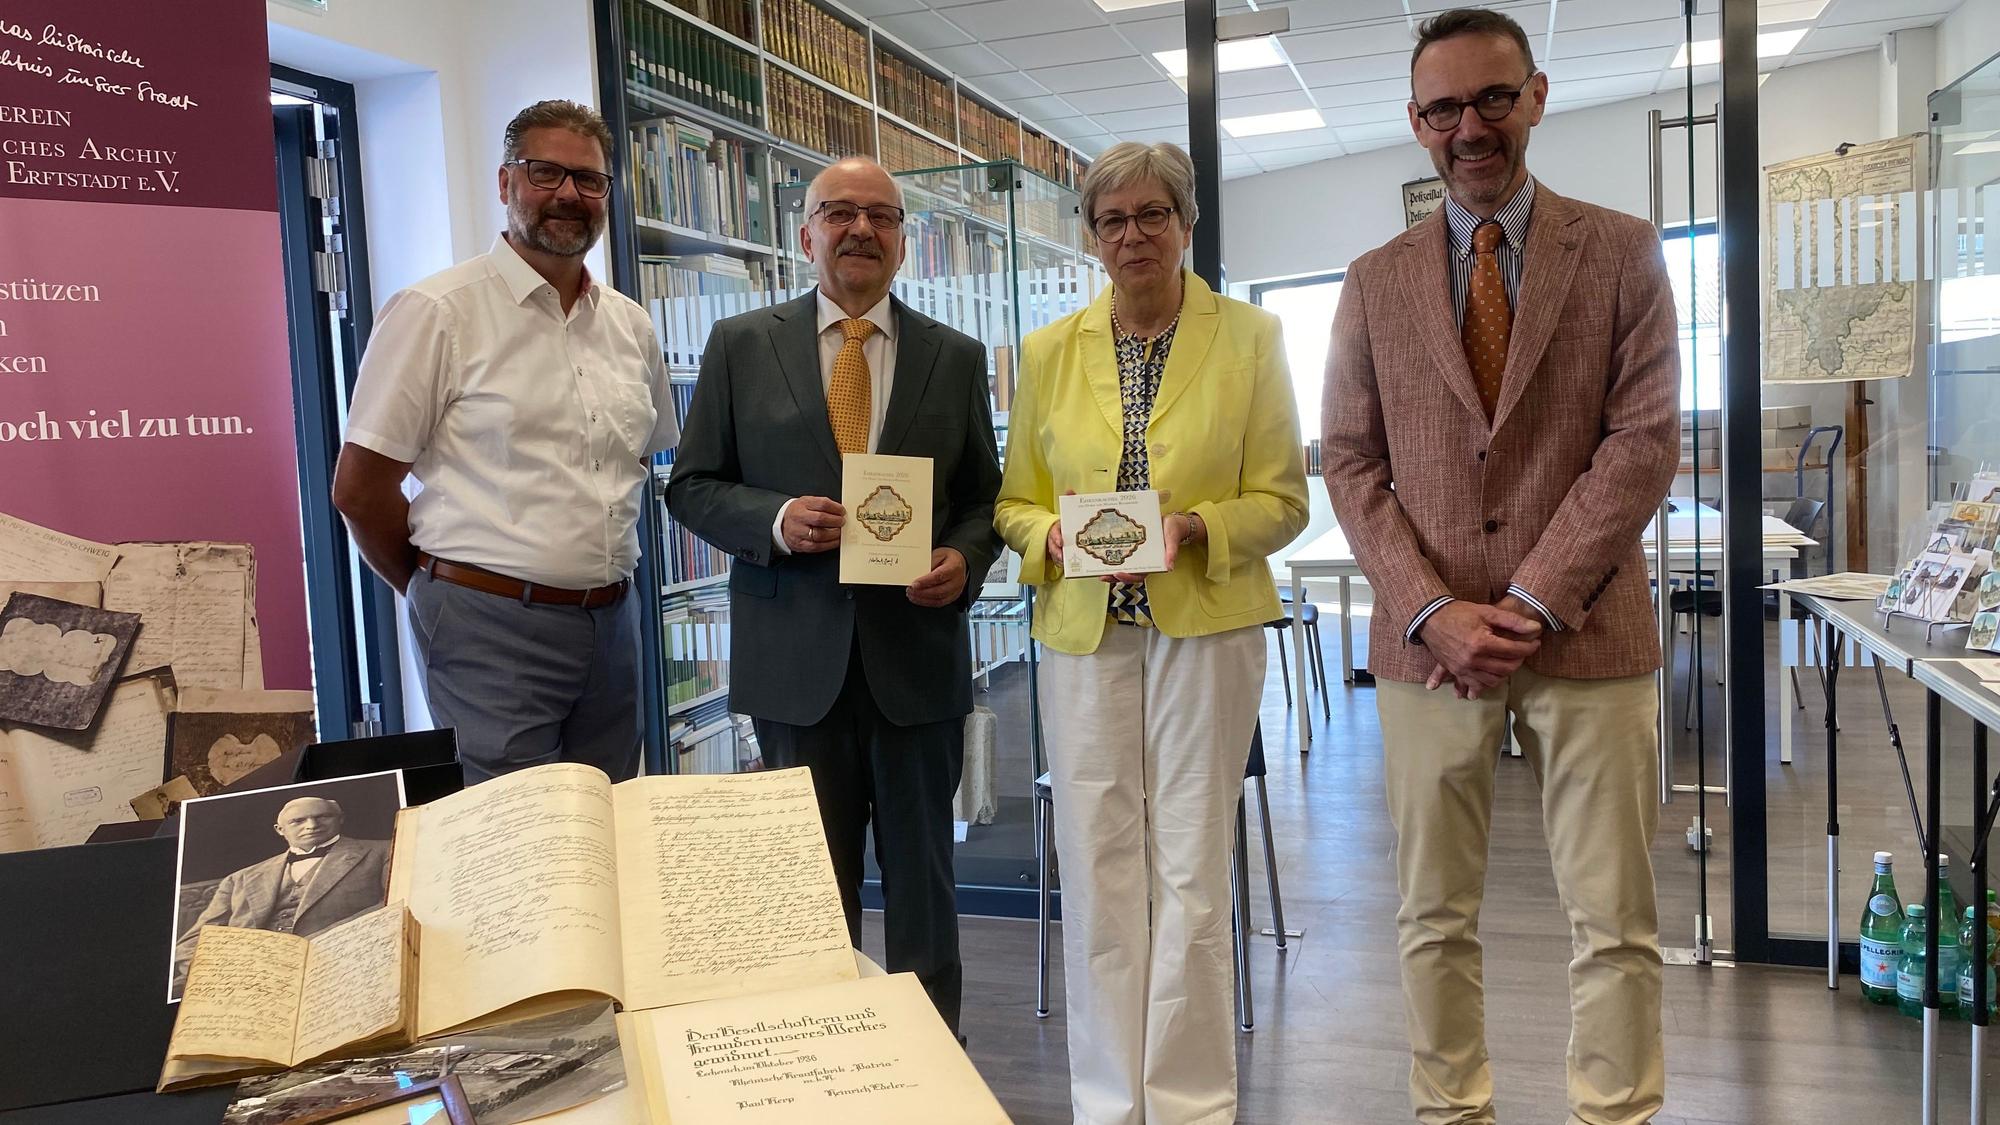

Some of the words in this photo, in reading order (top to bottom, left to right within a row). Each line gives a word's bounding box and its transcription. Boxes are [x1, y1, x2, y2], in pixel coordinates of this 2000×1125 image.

[138, 81, 198, 111] Stadt
[0, 411, 63, 442] och
[67, 409, 132, 440] viel
[139, 417, 180, 437] zu
[185, 413, 254, 436] tun.
[686, 1028, 718, 1042] Den
[717, 1015, 842, 1037] Gesellschaftern
[845, 1007, 876, 1021] und
[686, 1036, 761, 1056] Freunden
[764, 1029, 824, 1044] unseres
[823, 1020, 887, 1036] Werkes
[736, 1098, 764, 1110] Paul
